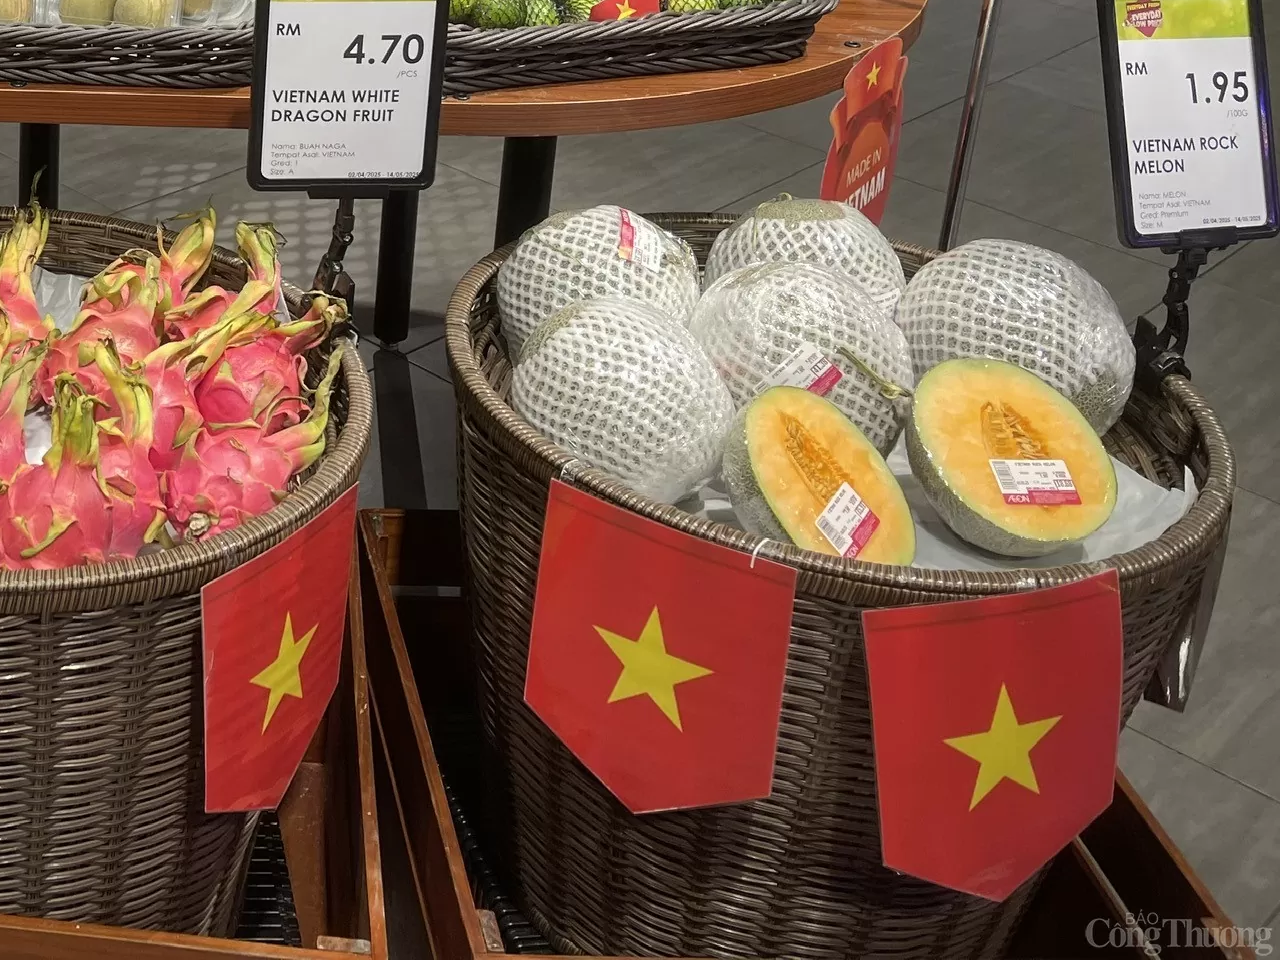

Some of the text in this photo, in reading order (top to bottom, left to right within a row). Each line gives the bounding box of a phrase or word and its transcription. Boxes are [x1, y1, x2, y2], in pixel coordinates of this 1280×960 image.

[1132, 10, 1161, 21] EVERYDAY
[276, 23, 301, 36] RM
[343, 34, 424, 65] 4.70
[396, 70, 418, 78] /PCS
[1125, 62, 1148, 76] RM
[1185, 71, 1249, 104] 1.95
[272, 89, 400, 103] VIETNAM WHITE
[271, 109, 394, 122] DRAGON FRUIT
[1226, 109, 1248, 118] /100G
[1133, 136, 1239, 153] VIETNAM ROCK
[271, 151, 300, 159] Tempat
[846, 147, 882, 188] MADE IN
[1134, 159, 1185, 175] MELON
